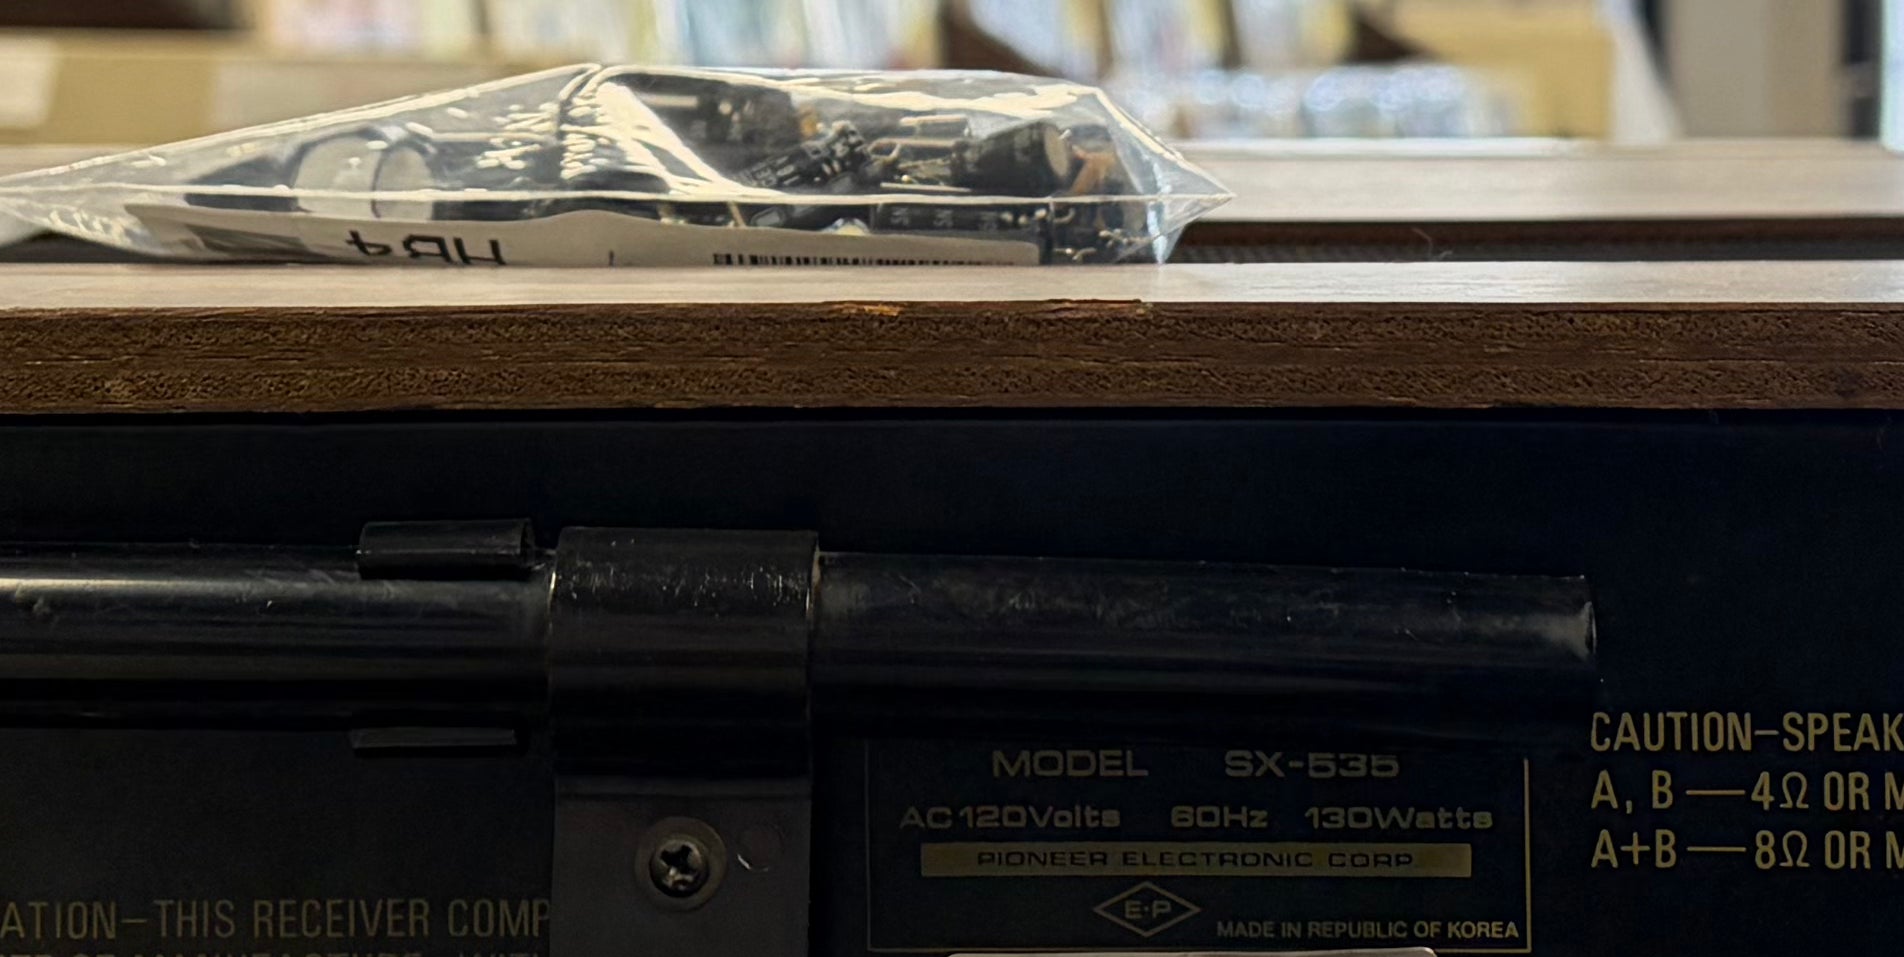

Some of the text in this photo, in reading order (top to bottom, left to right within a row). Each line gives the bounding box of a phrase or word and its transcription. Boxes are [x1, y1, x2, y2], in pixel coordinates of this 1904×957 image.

[992, 749, 1400, 779] MODEL SX-535
[1823, 770, 1870, 812] OR
[1170, 805, 1268, 828] 60Hz
[1304, 806, 1494, 830] 130Watts
[976, 851, 1108, 868] PIONEER
[1122, 850, 1314, 868] ELECTRONIC
[1824, 829, 1871, 870] OR
[252, 898, 430, 939] RECEIVER
[1216, 920, 1519, 939] MADE IN REPUBLIC OF KOREA
